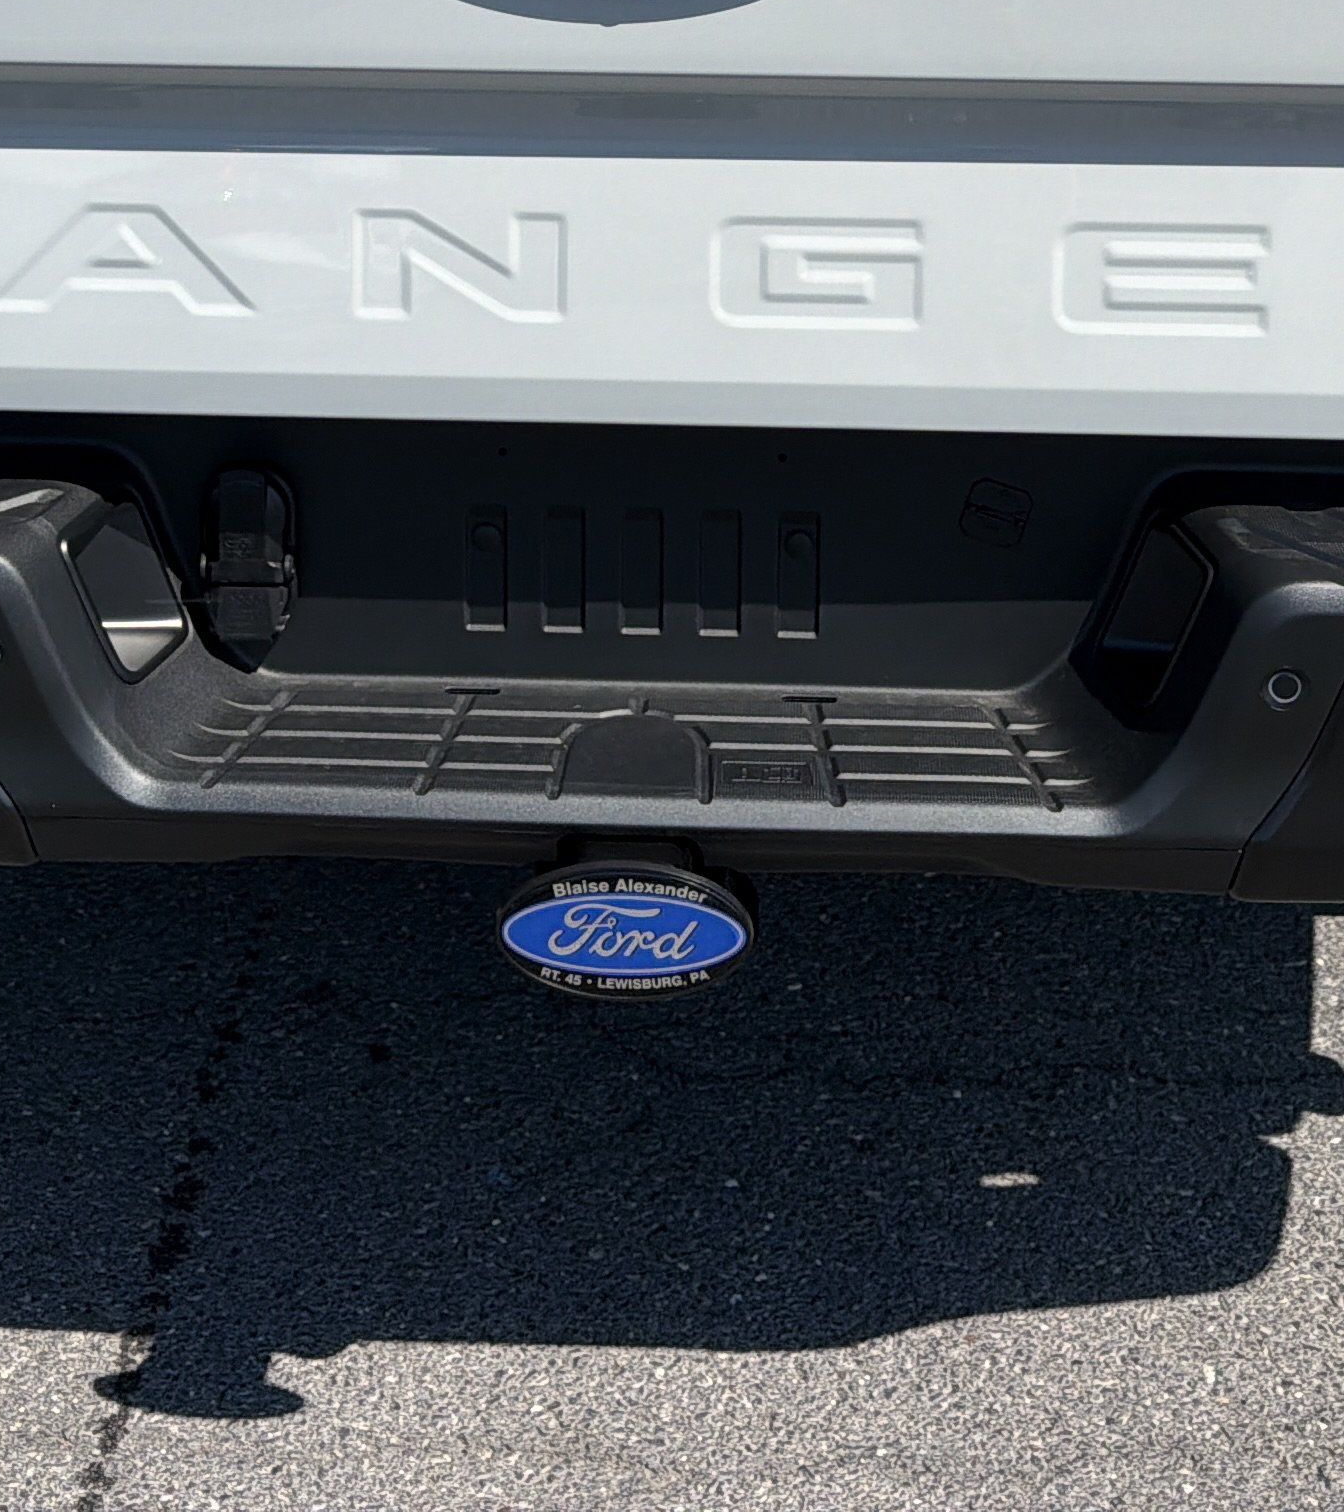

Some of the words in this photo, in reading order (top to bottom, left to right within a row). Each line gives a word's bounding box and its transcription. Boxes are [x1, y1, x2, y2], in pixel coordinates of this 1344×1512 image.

[552, 879, 609, 898] Blaise
[614, 878, 708, 904] Alexander
[547, 903, 699, 960] Ford
[541, 967, 562, 982] RT.
[565, 972, 582, 986] 45
[690, 970, 711, 984] PA
